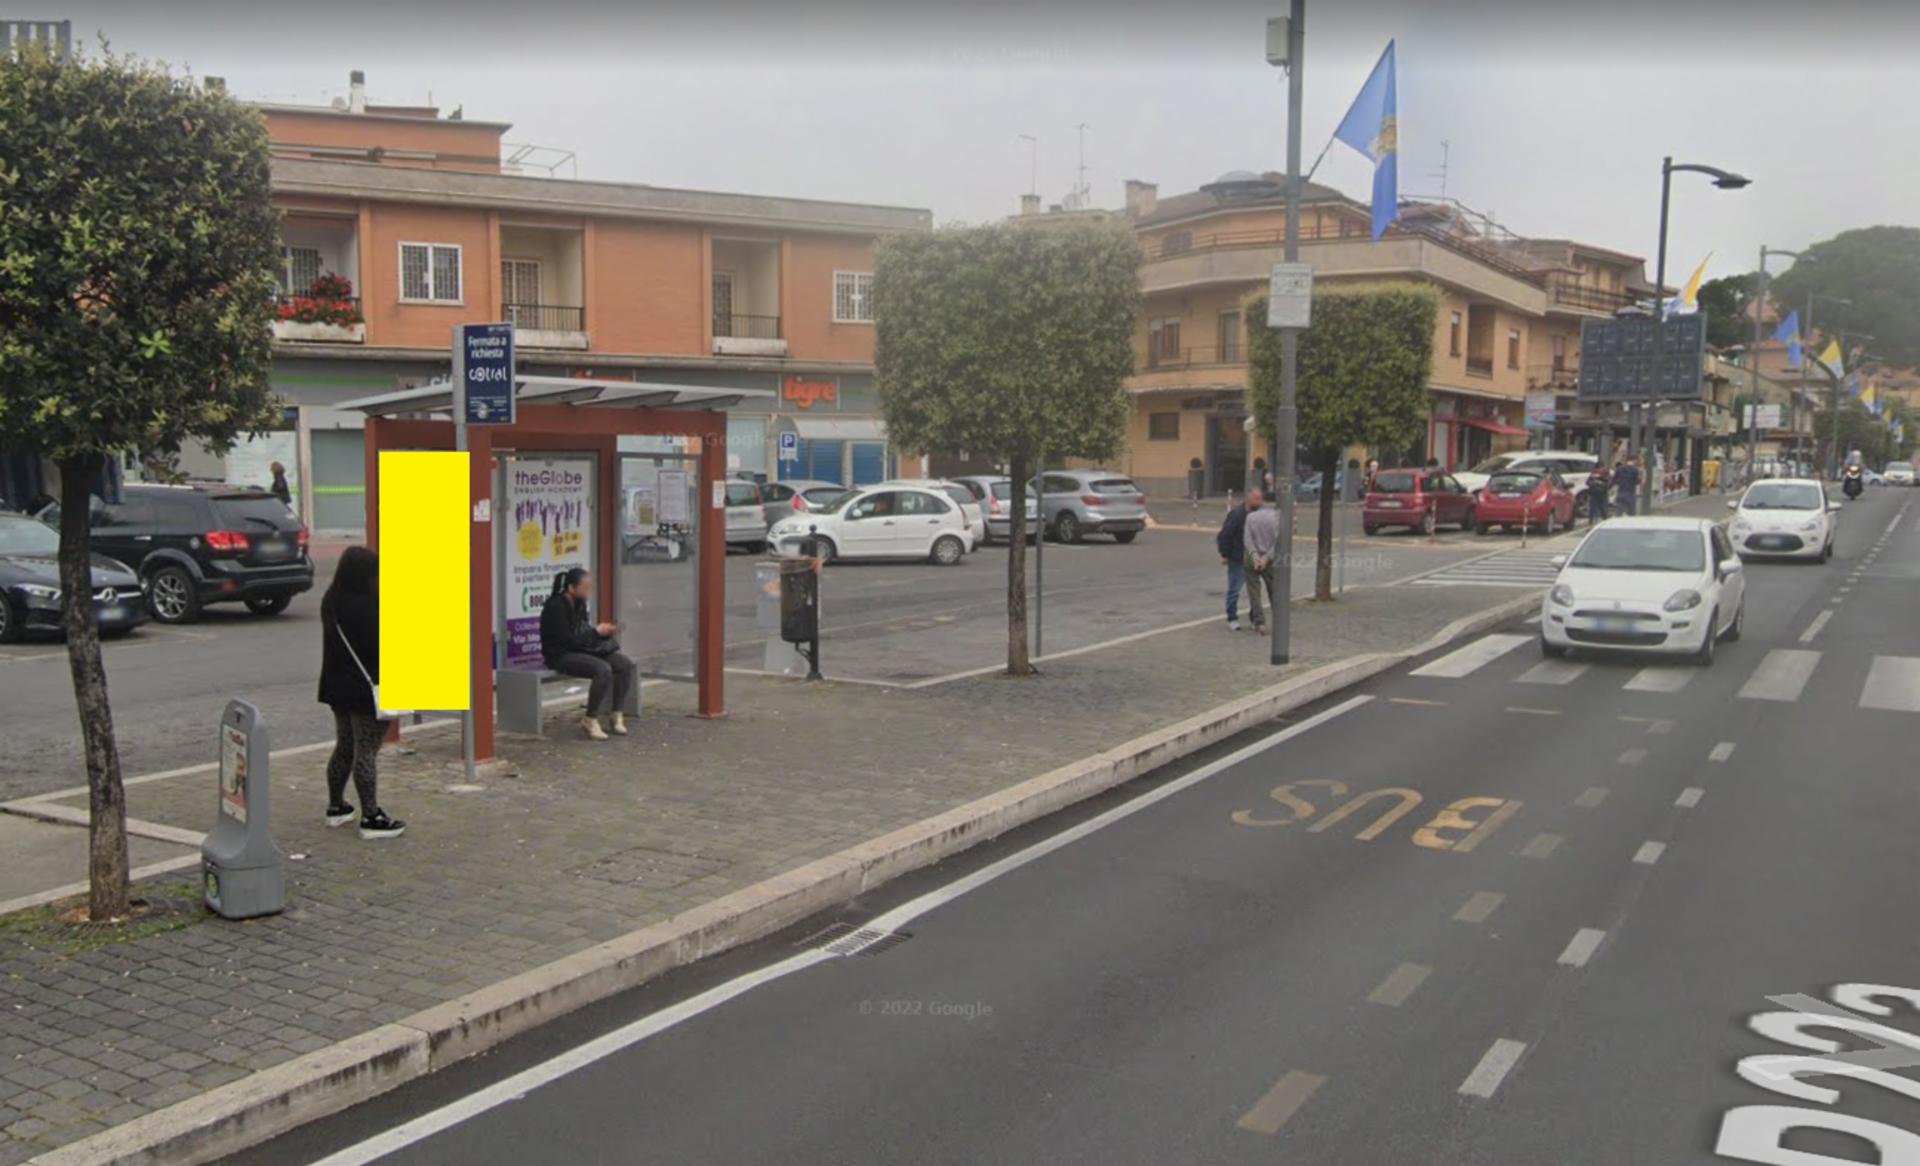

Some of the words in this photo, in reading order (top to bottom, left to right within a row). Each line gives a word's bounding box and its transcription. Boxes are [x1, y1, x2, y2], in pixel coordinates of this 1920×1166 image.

[468, 335, 500, 347] Fermata
[471, 347, 504, 359] richiesta
[468, 366, 508, 382] cotral
[515, 470, 583, 486] theGlobe
[1231, 778, 1524, 853] BUS
